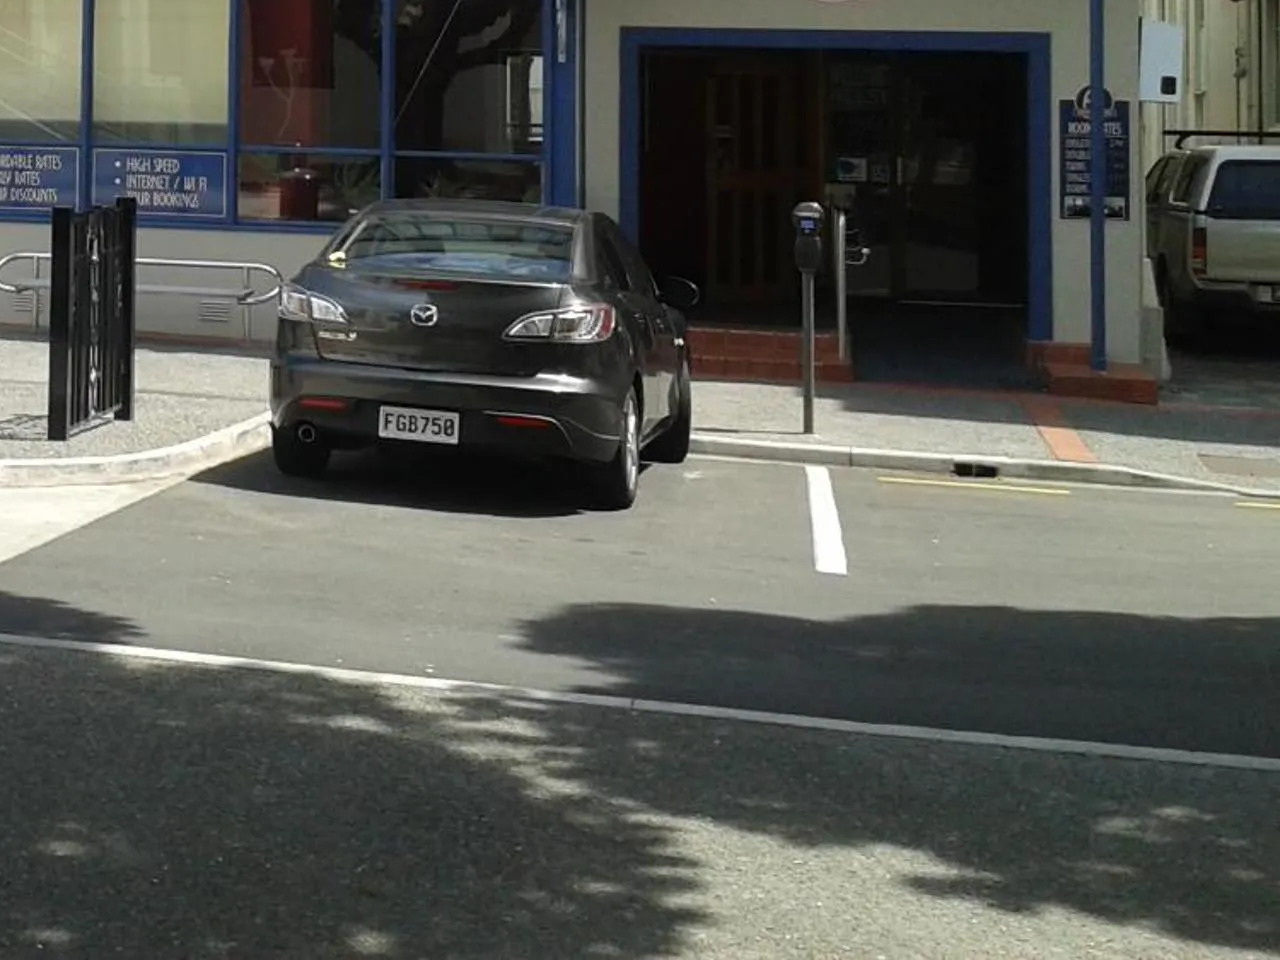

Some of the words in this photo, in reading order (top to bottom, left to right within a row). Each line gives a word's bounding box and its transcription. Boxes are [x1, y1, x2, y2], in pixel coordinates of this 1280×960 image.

[35, 154, 62, 170] RATES
[125, 156, 151, 172] HIGH
[153, 156, 181, 174] SPEED
[14, 170, 41, 186] RATES
[126, 173, 170, 189] INTERNET
[10, 187, 58, 203] DISCOUNTS
[153, 190, 200, 209] BOOKINGS
[384, 412, 456, 438] FGB750
